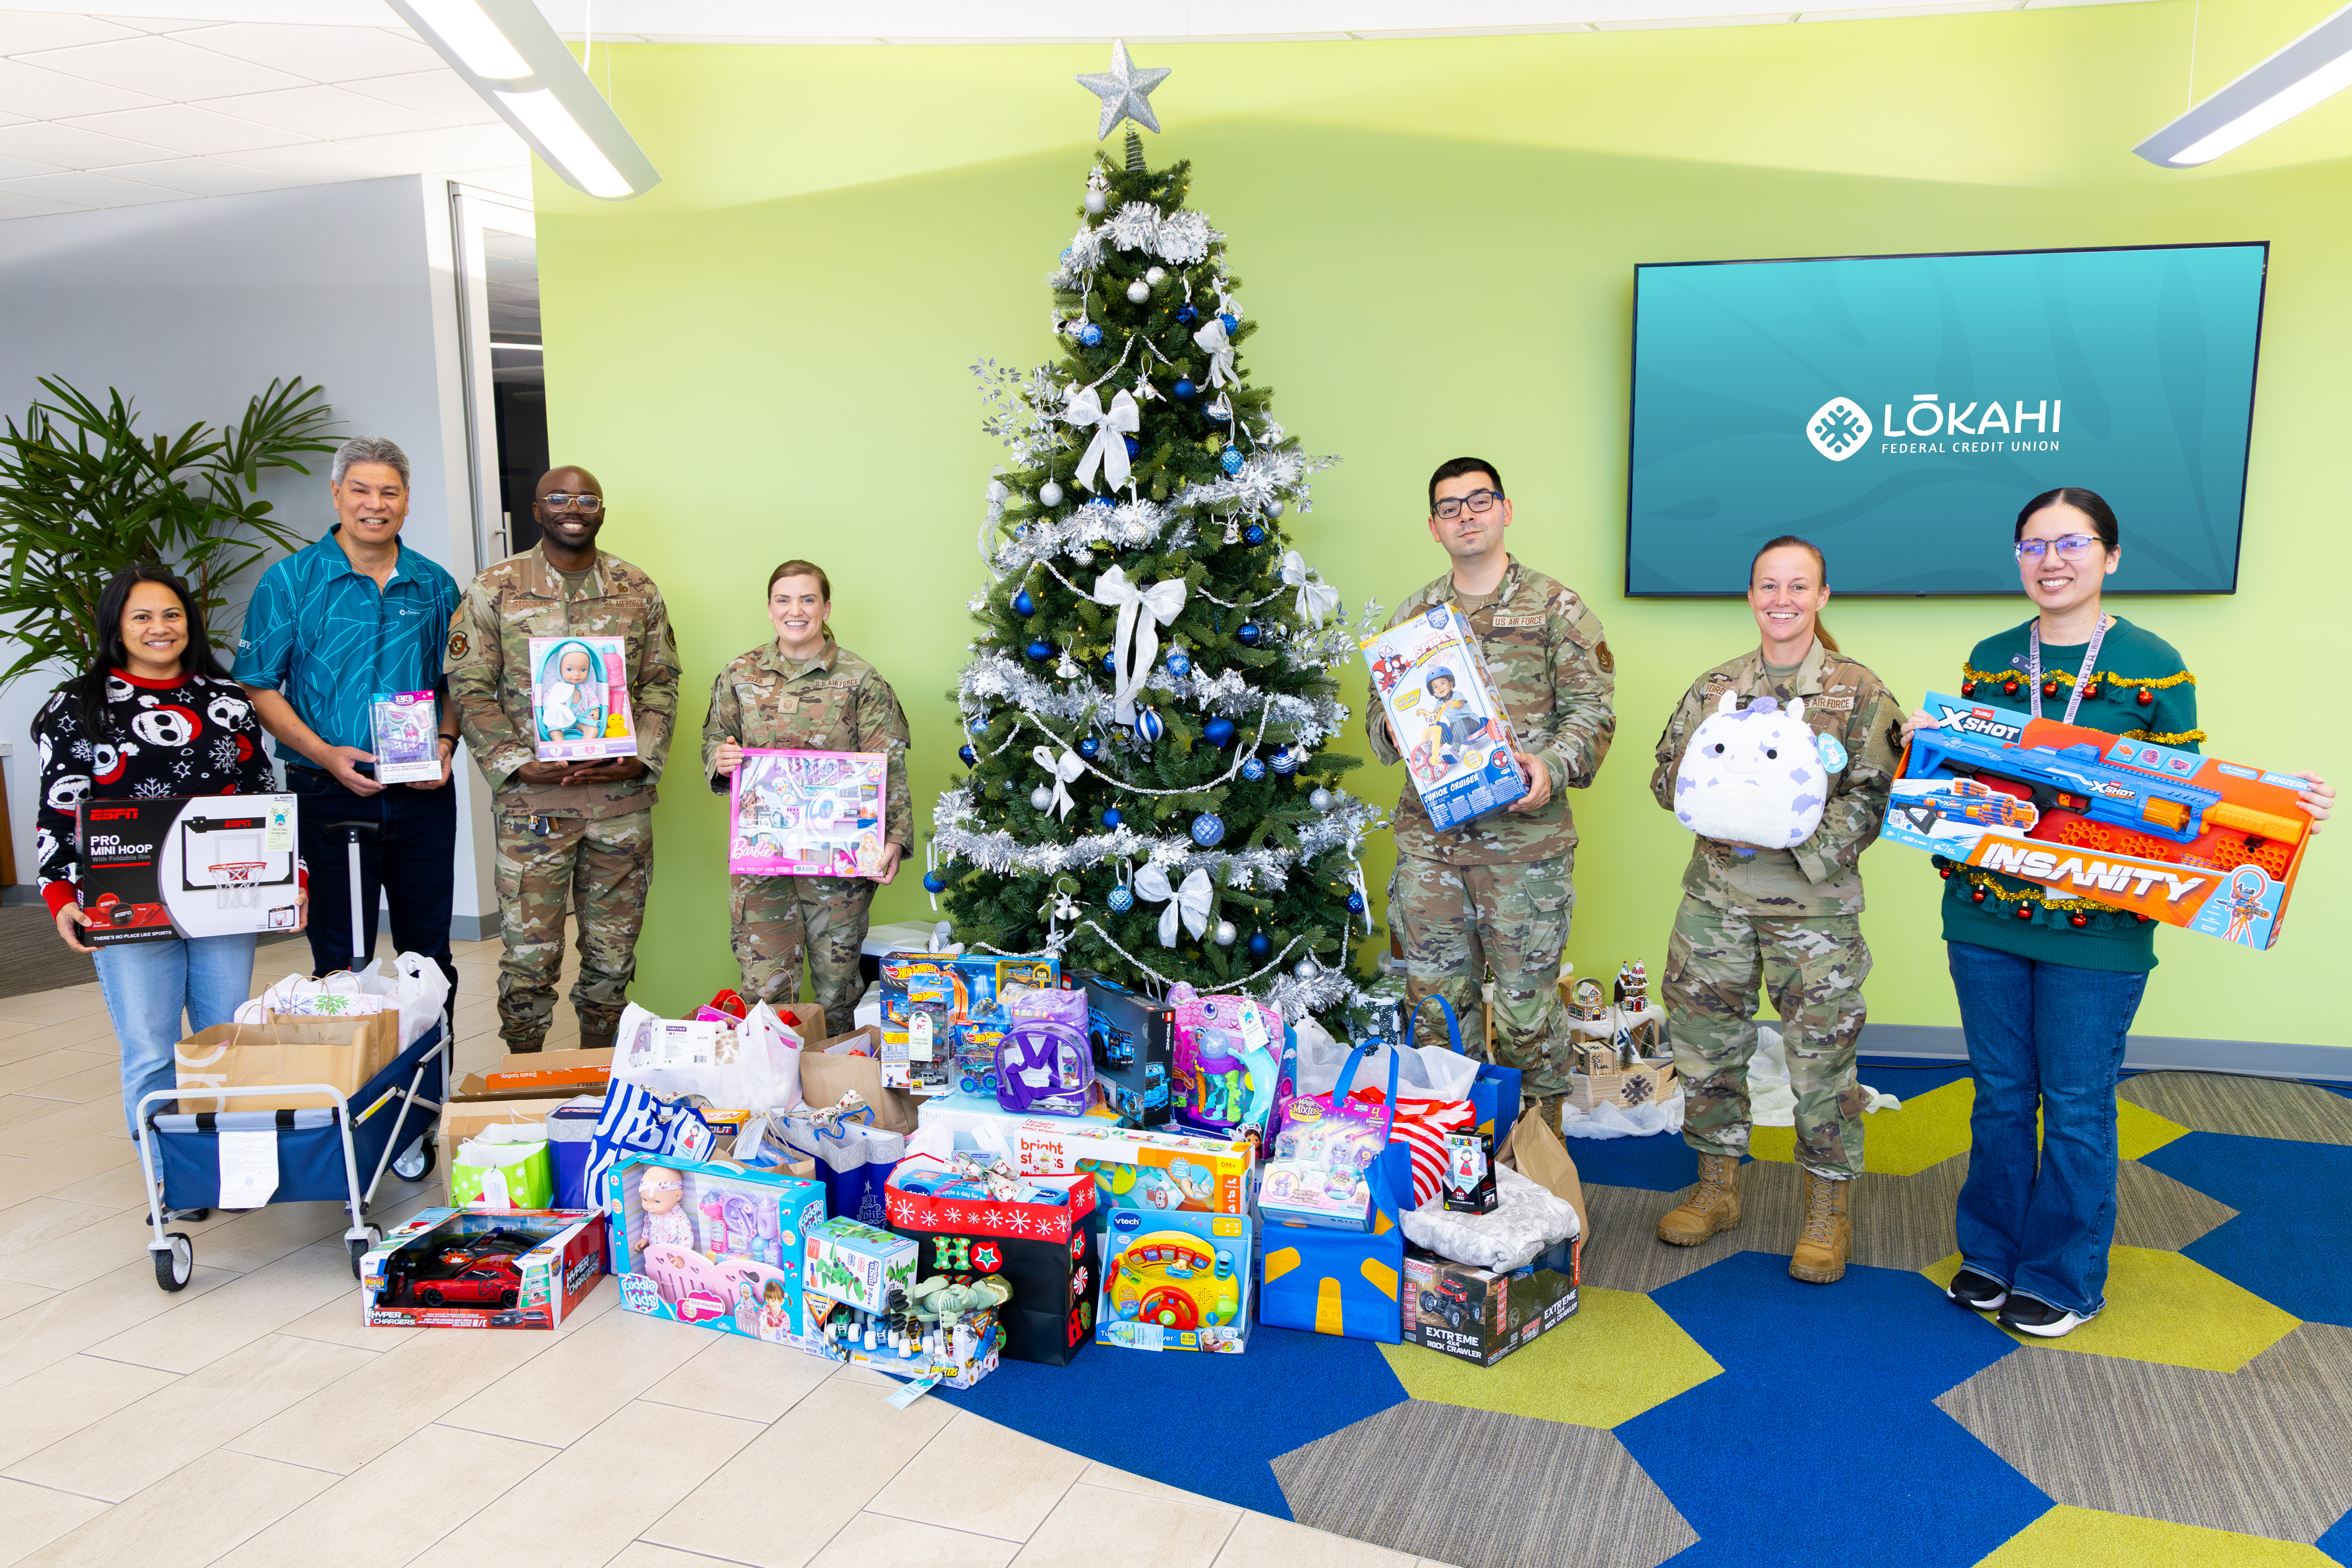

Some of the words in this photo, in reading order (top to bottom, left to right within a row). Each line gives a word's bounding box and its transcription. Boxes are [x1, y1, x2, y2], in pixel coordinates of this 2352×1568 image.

[1884, 394, 2061, 437] LŌKAHI
[1882, 443, 1945, 453] FEDERAL
[1953, 442, 2004, 452] CREDIT
[2011, 441, 2060, 452] UNION
[1522, 616, 1542, 625] FORCE
[1413, 630, 1456, 659] SPIDEY
[2089, 631, 2103, 652] KUROMI
[1416, 647, 1438, 669] AMAZING
[1437, 639, 1461, 652] FRIENDS
[745, 675, 764, 684] GREEN
[395, 694, 414, 703] 3C4G
[1974, 709, 1992, 718] ZURU
[2065, 697, 2080, 720] KUROMI
[1424, 786, 1449, 804] JUNIOR
[1450, 773, 1480, 792] CRUISER
[90, 807, 139, 821] ESPN
[225, 820, 251, 828] ESPN
[90, 835, 121, 847] PRO
[91, 846, 116, 856] MINI
[118, 844, 153, 855] HOOP
[732, 837, 775, 859] Barbie
[1979, 842, 2207, 902] INSANITY
[114, 910, 132, 918] ESPN
[898, 967, 913, 979] HOT
[912, 993, 924, 1001] HOT
[974, 1034, 986, 1043] HOT
[1298, 1098, 1316, 1106] Magic
[1370, 1107, 1381, 1117] 4
[1451, 1138, 1472, 1146] RUBIK'S
[862, 1195, 878, 1205] BEST
[960, 1191, 970, 1199] day
[800, 1202, 823, 1227] cuddle
[857, 1209, 886, 1222] WISHES
[566, 1254, 589, 1283] HYPER
[1403, 1261, 1434, 1275] SUPER
[365, 1276, 385, 1288] HEAT
[569, 1258, 599, 1297] CHARGERS
[623, 1279, 656, 1291] cuddle
[528, 1296, 547, 1305] TURBO
[630, 1291, 658, 1308] kids
[809, 1301, 831, 1310] MONSTER
[1544, 1289, 1577, 1320] EXTREME
[371, 1311, 402, 1319] HYPER
[1545, 1319, 1556, 1331] ROCK
[1557, 1302, 1578, 1322] CRAWLER
[472, 1319, 487, 1327] R/C
[1521, 1316, 1541, 1337] SUPER
[1426, 1326, 1479, 1347] EXTREME
[1426, 1340, 1445, 1350] ROCK
[1447, 1345, 1482, 1359] CRAWLER
